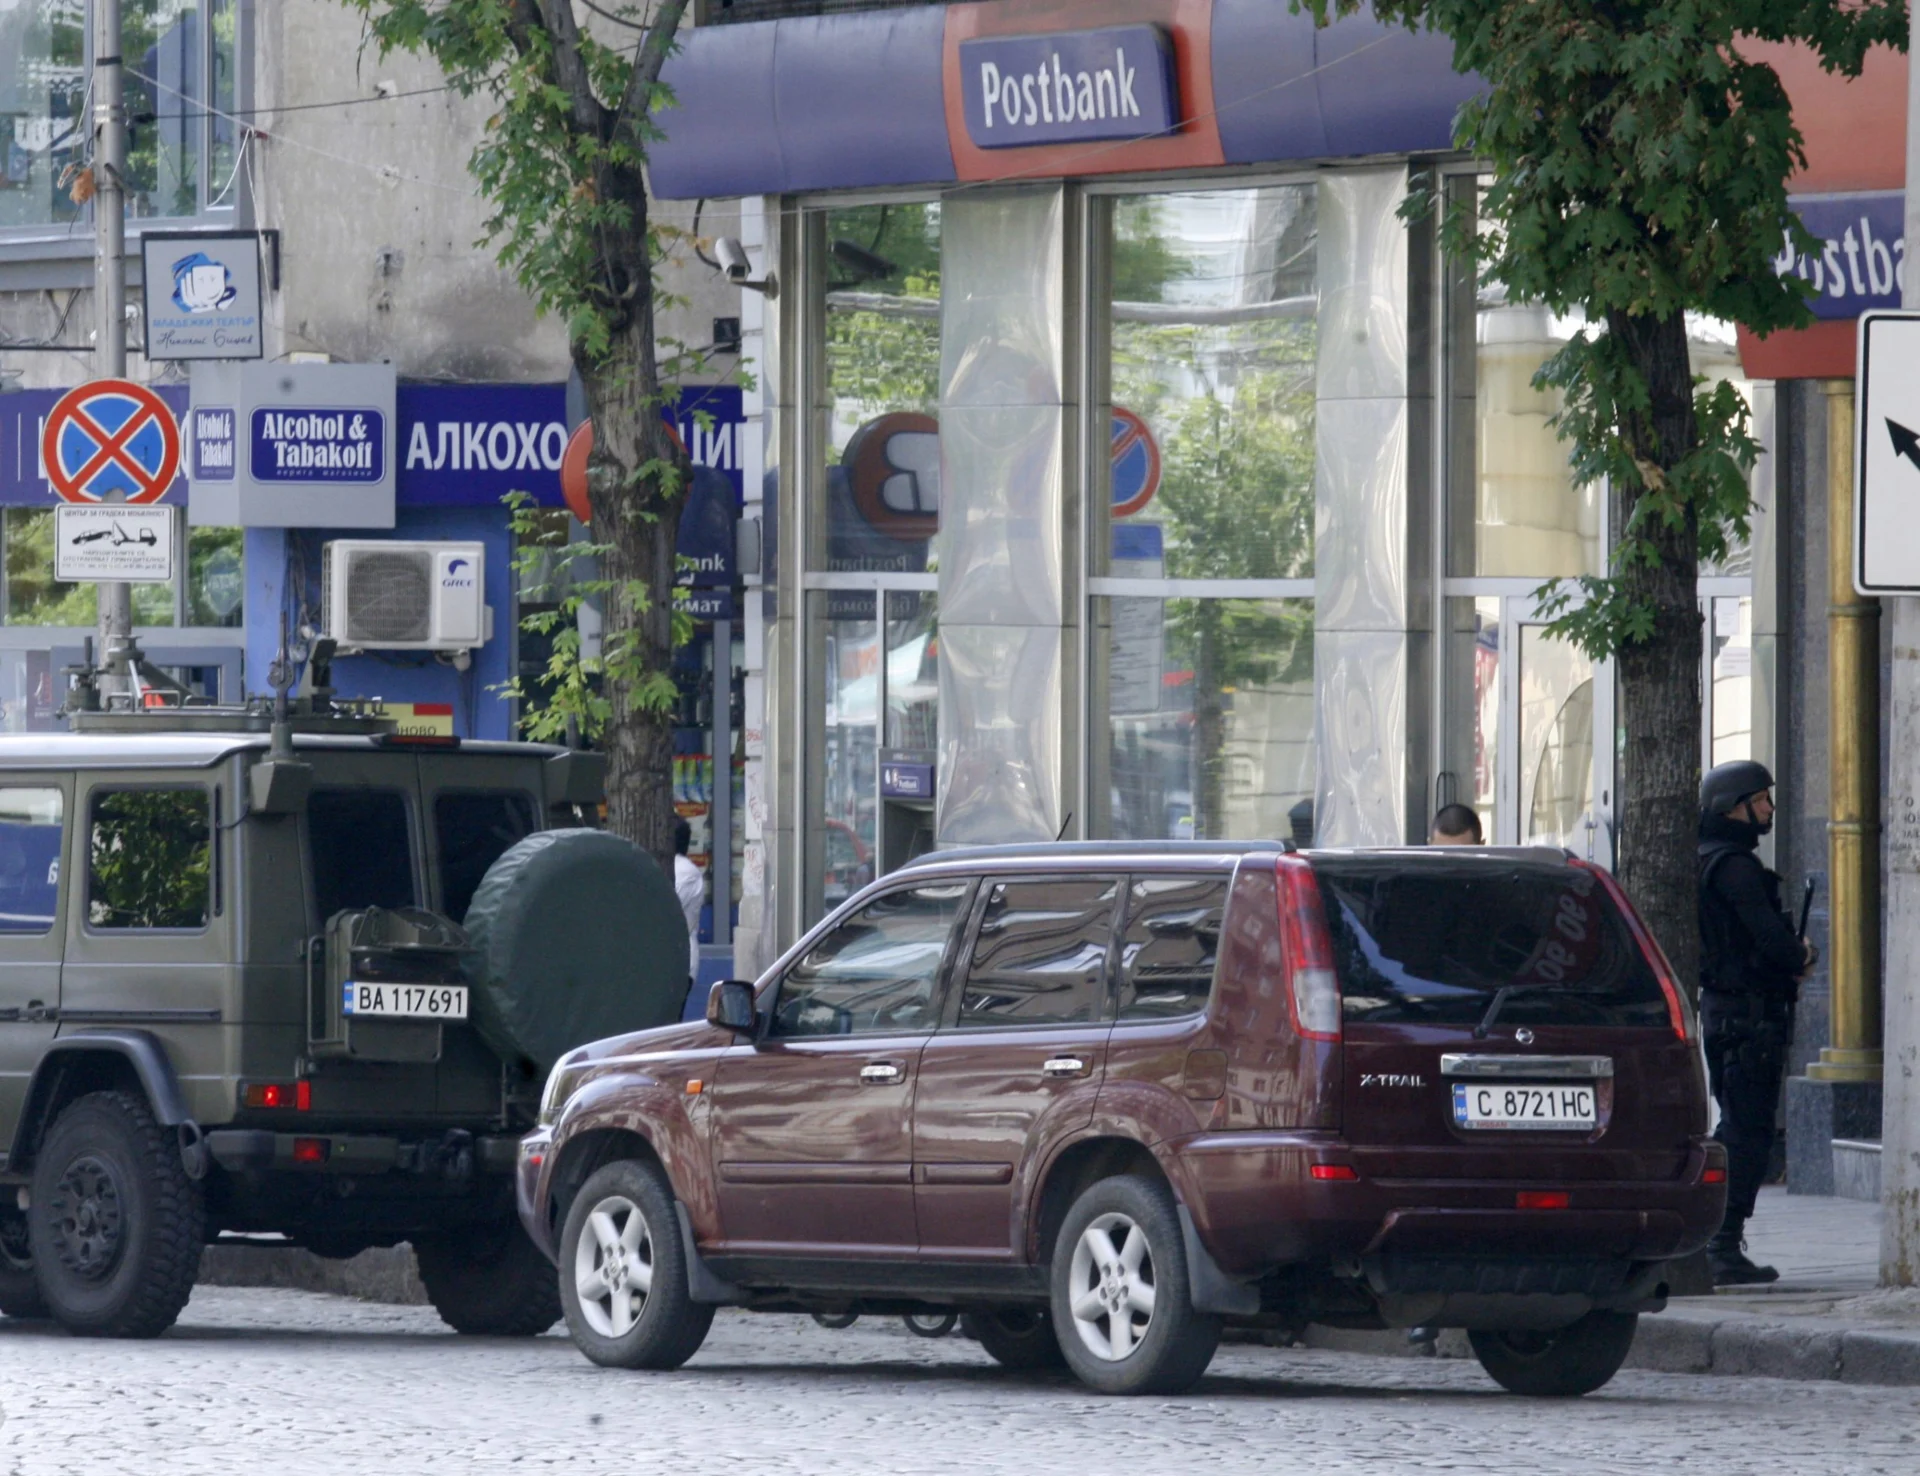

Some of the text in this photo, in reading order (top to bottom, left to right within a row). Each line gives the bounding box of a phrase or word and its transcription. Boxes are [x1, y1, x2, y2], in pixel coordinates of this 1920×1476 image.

[981, 47, 1140, 128] Postbank
[216, 315, 255, 328] ТЕАТЪР
[197, 412, 232, 439] Alcohol &
[262, 413, 367, 440] Alcohol &
[200, 441, 232, 467] Tabakoff
[274, 441, 372, 468] Tabakoff
[405, 421, 569, 471] АЛКОХО
[359, 987, 463, 1014] BA 117691
[1360, 1074, 1427, 1087] X-TRAIL
